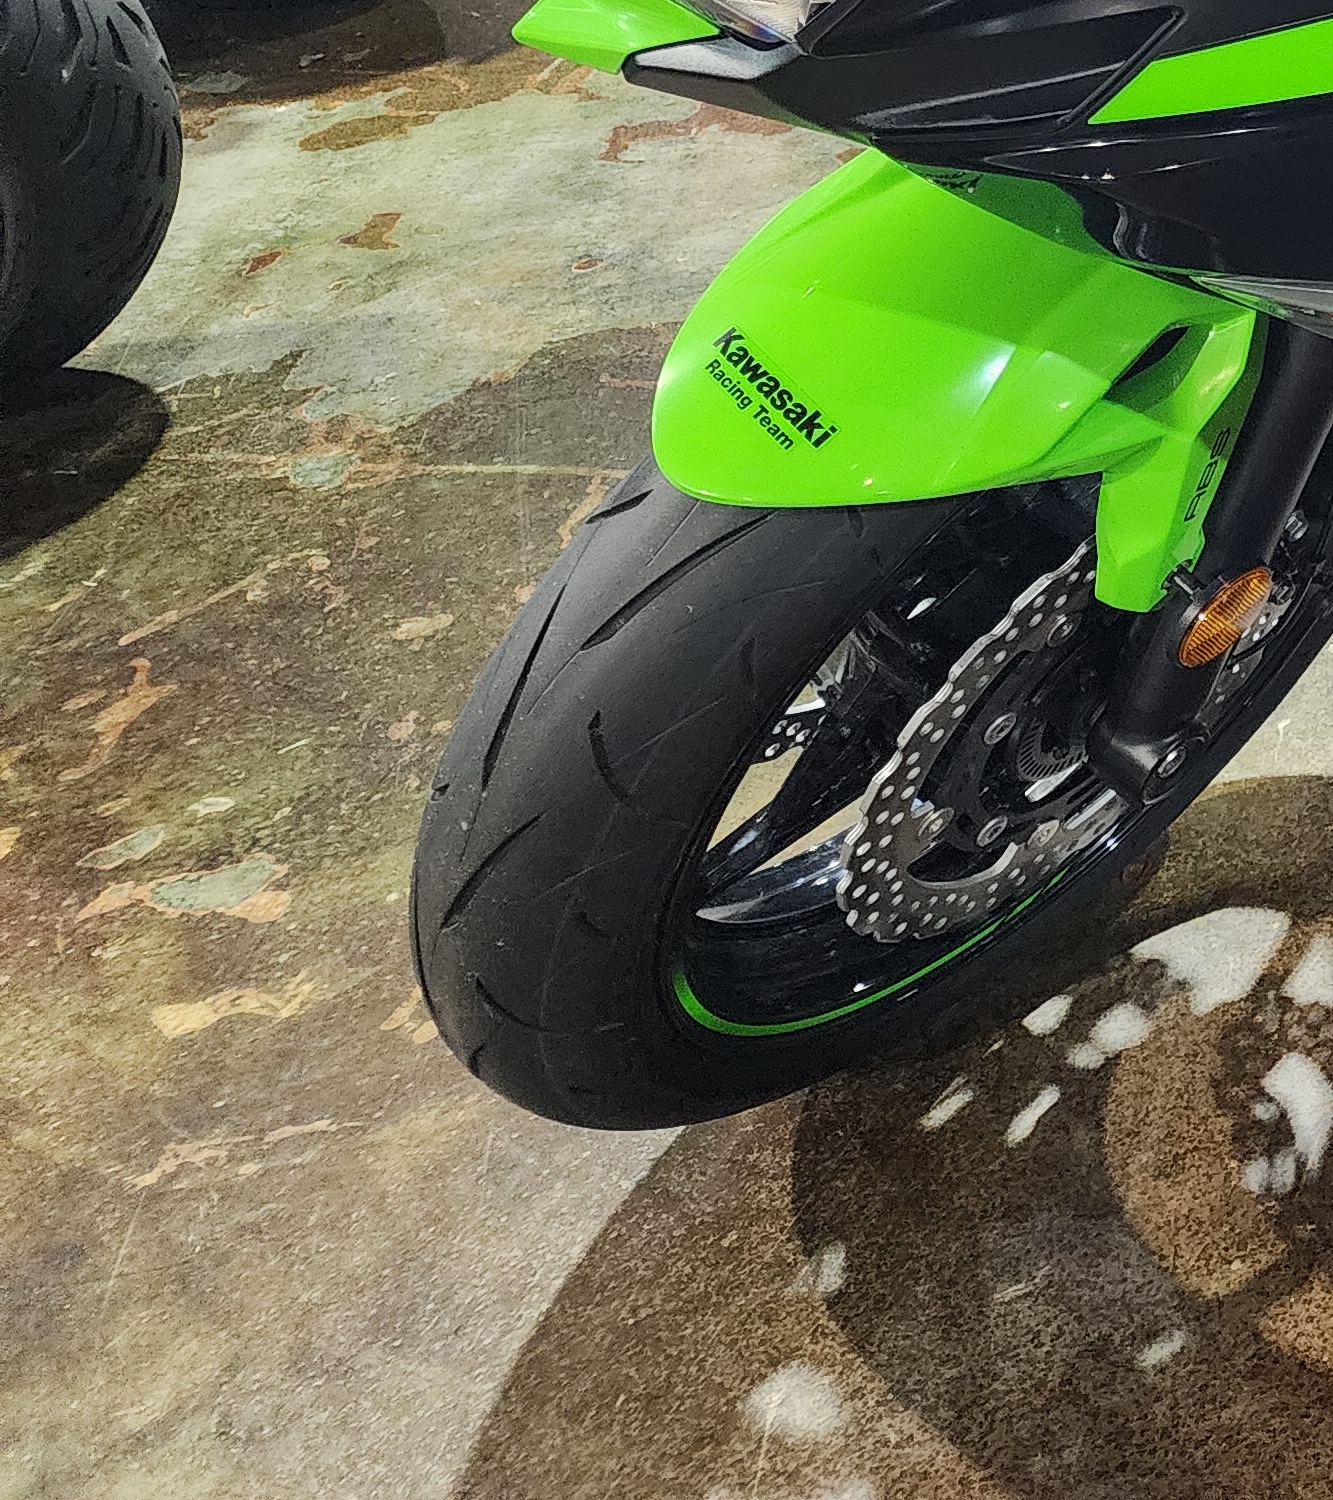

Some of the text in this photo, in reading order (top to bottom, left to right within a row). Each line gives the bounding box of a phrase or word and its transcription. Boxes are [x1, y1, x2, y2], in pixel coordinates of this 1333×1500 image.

[704, 358, 795, 451] Racing Team
[712, 326, 838, 449] Kawasaki
[1184, 427, 1231, 523] ABS
